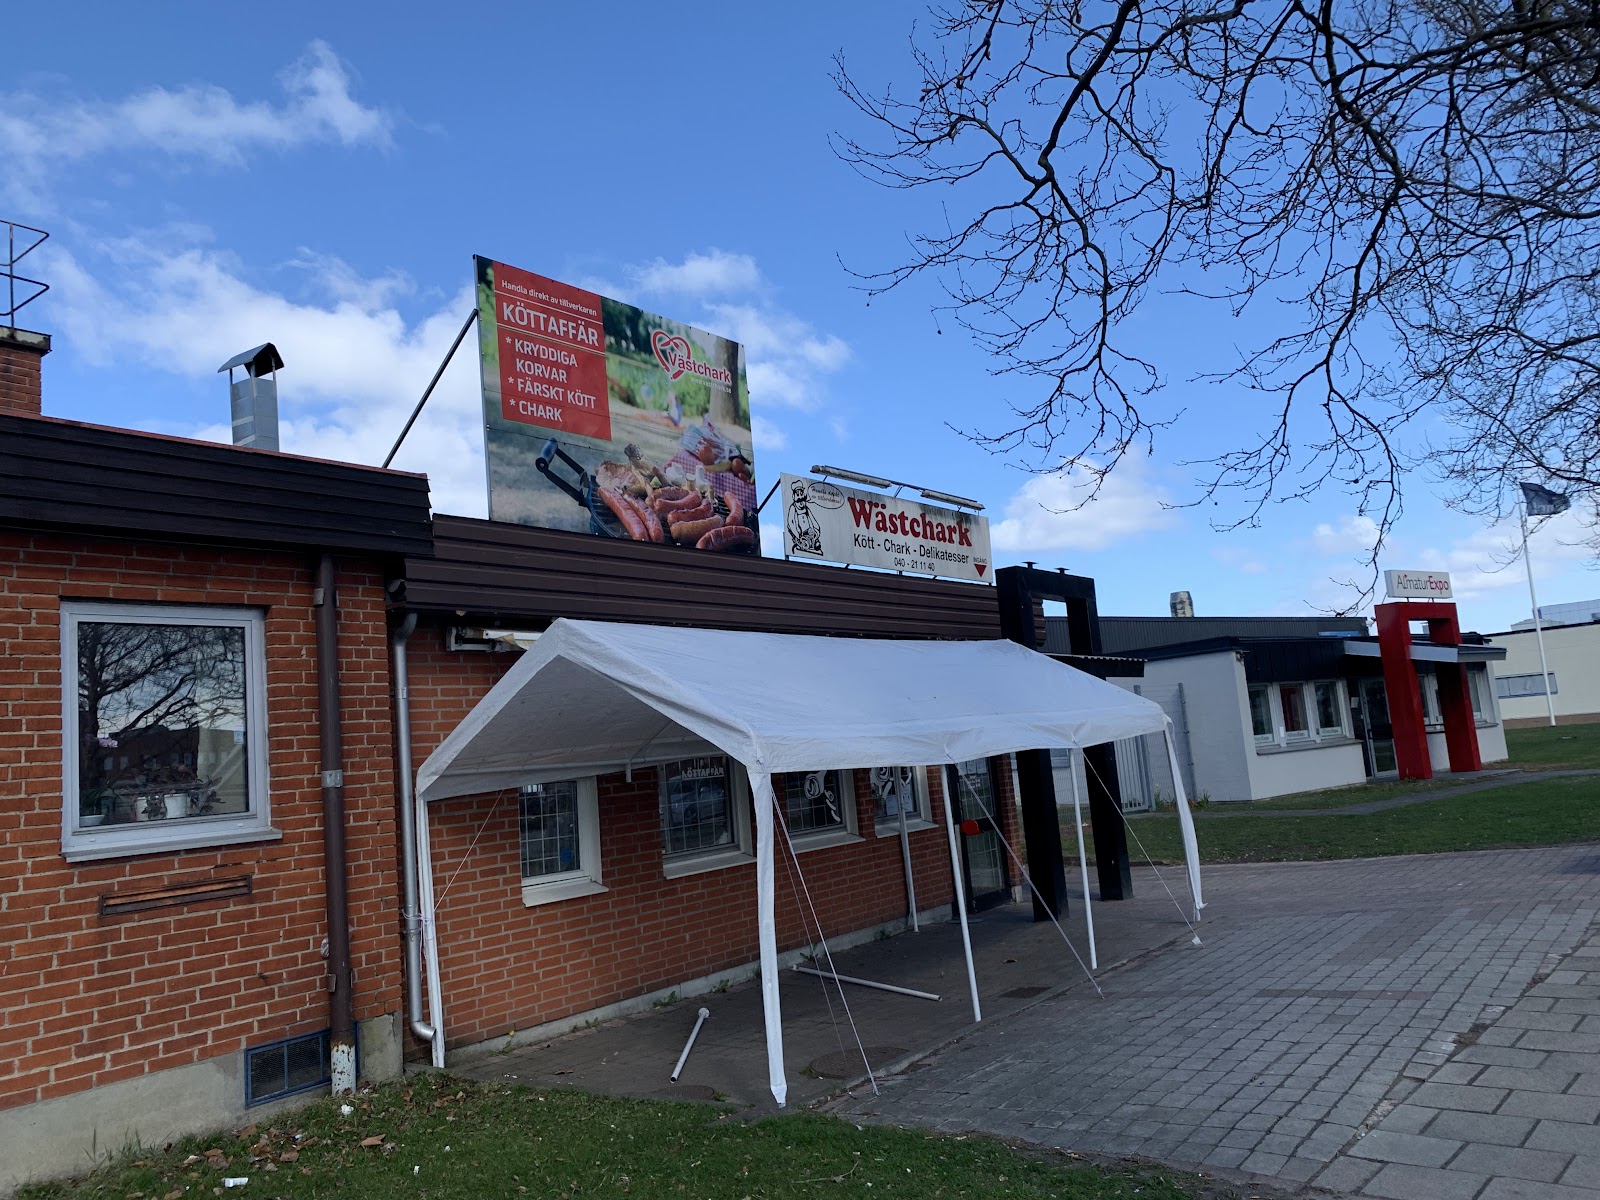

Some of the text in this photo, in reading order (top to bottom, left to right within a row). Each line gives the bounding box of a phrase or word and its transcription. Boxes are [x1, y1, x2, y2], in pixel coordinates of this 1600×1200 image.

[501, 279, 598, 317] Handla direkt av tillverkaren
[502, 301, 599, 347] KÖTTAFFÄR
[514, 338, 578, 368] KRYDDIGA
[668, 351, 731, 384] Västchark
[515, 358, 568, 384] KORVAR
[517, 376, 597, 410] FÄRSKT KÖTT
[518, 400, 563, 422] CHARK
[847, 496, 973, 547] Wästchark
[853, 533, 875, 550] Kött
[883, 538, 911, 556] Chark
[919, 544, 970, 564] Delikatesser
[894, 557, 906, 568] 040
[911, 559, 918, 570] 21
[927, 562, 936, 572] 40
